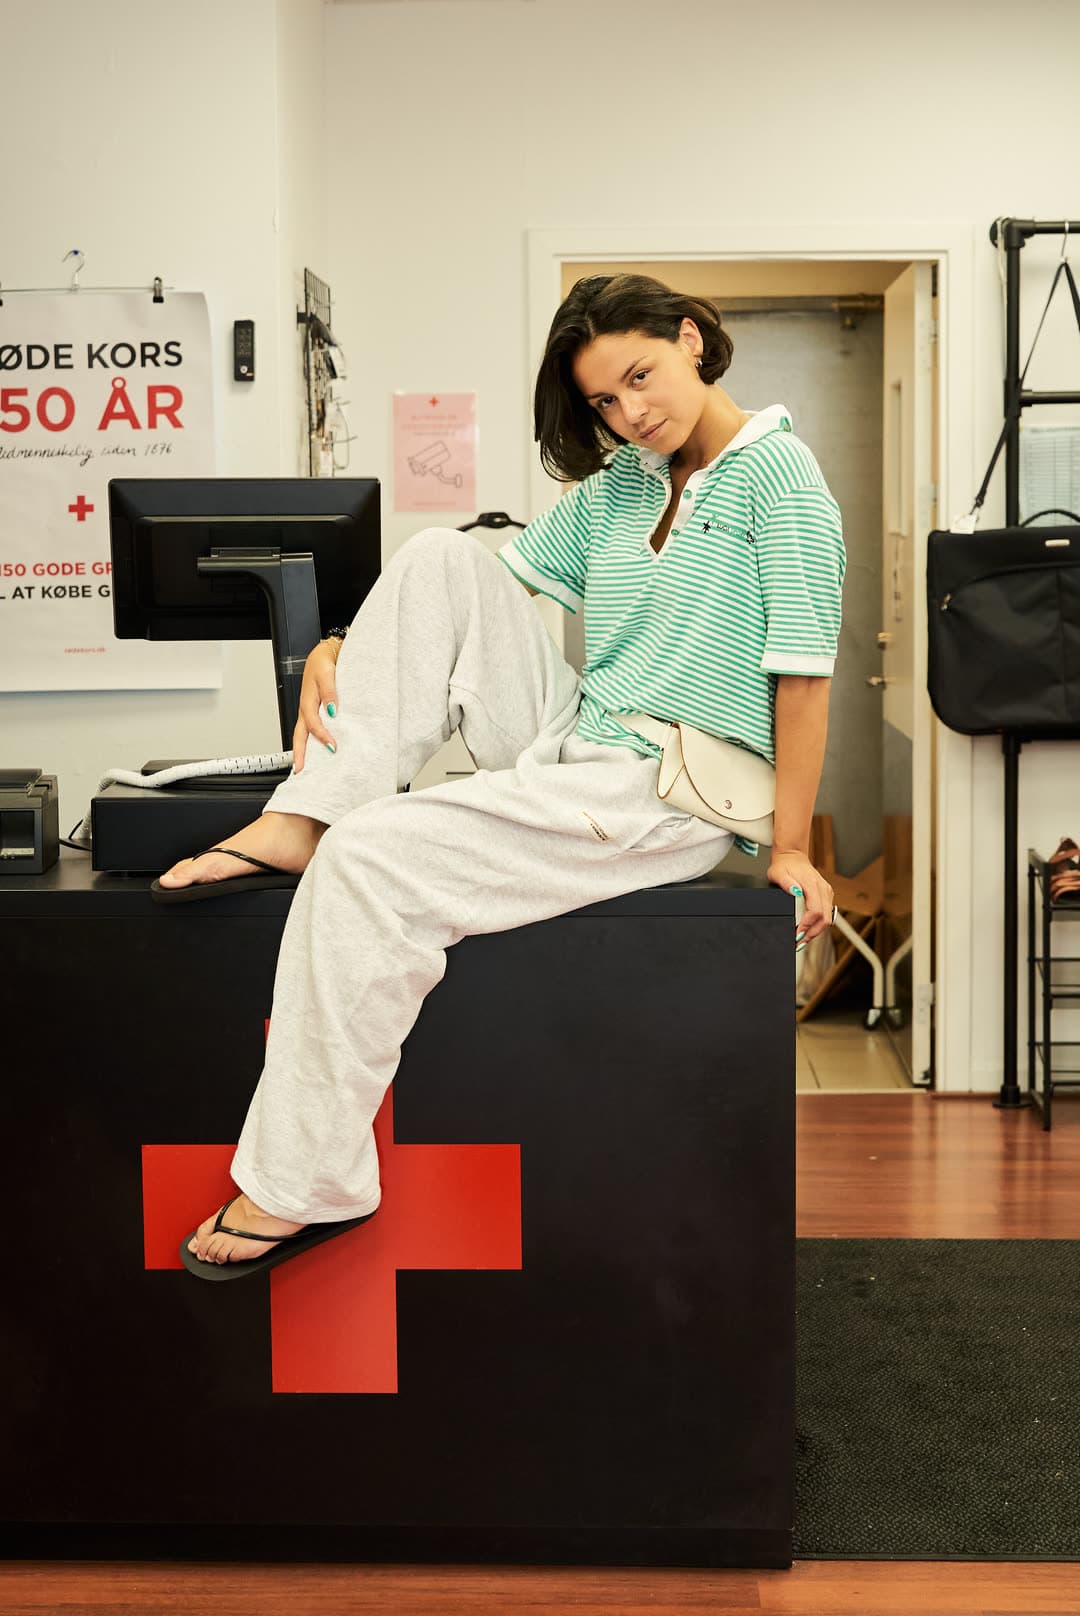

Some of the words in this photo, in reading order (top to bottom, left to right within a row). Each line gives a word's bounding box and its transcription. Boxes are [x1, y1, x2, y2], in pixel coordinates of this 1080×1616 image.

[0, 344, 73, 370] ØDE
[87, 341, 183, 369] KORS
[0, 386, 76, 433] 50
[97, 376, 184, 431] ÅR
[32, 562, 86, 576] GODE
[12, 585, 35, 600] AT
[41, 584, 92, 599] KØBE
[98, 584, 111, 598] G
